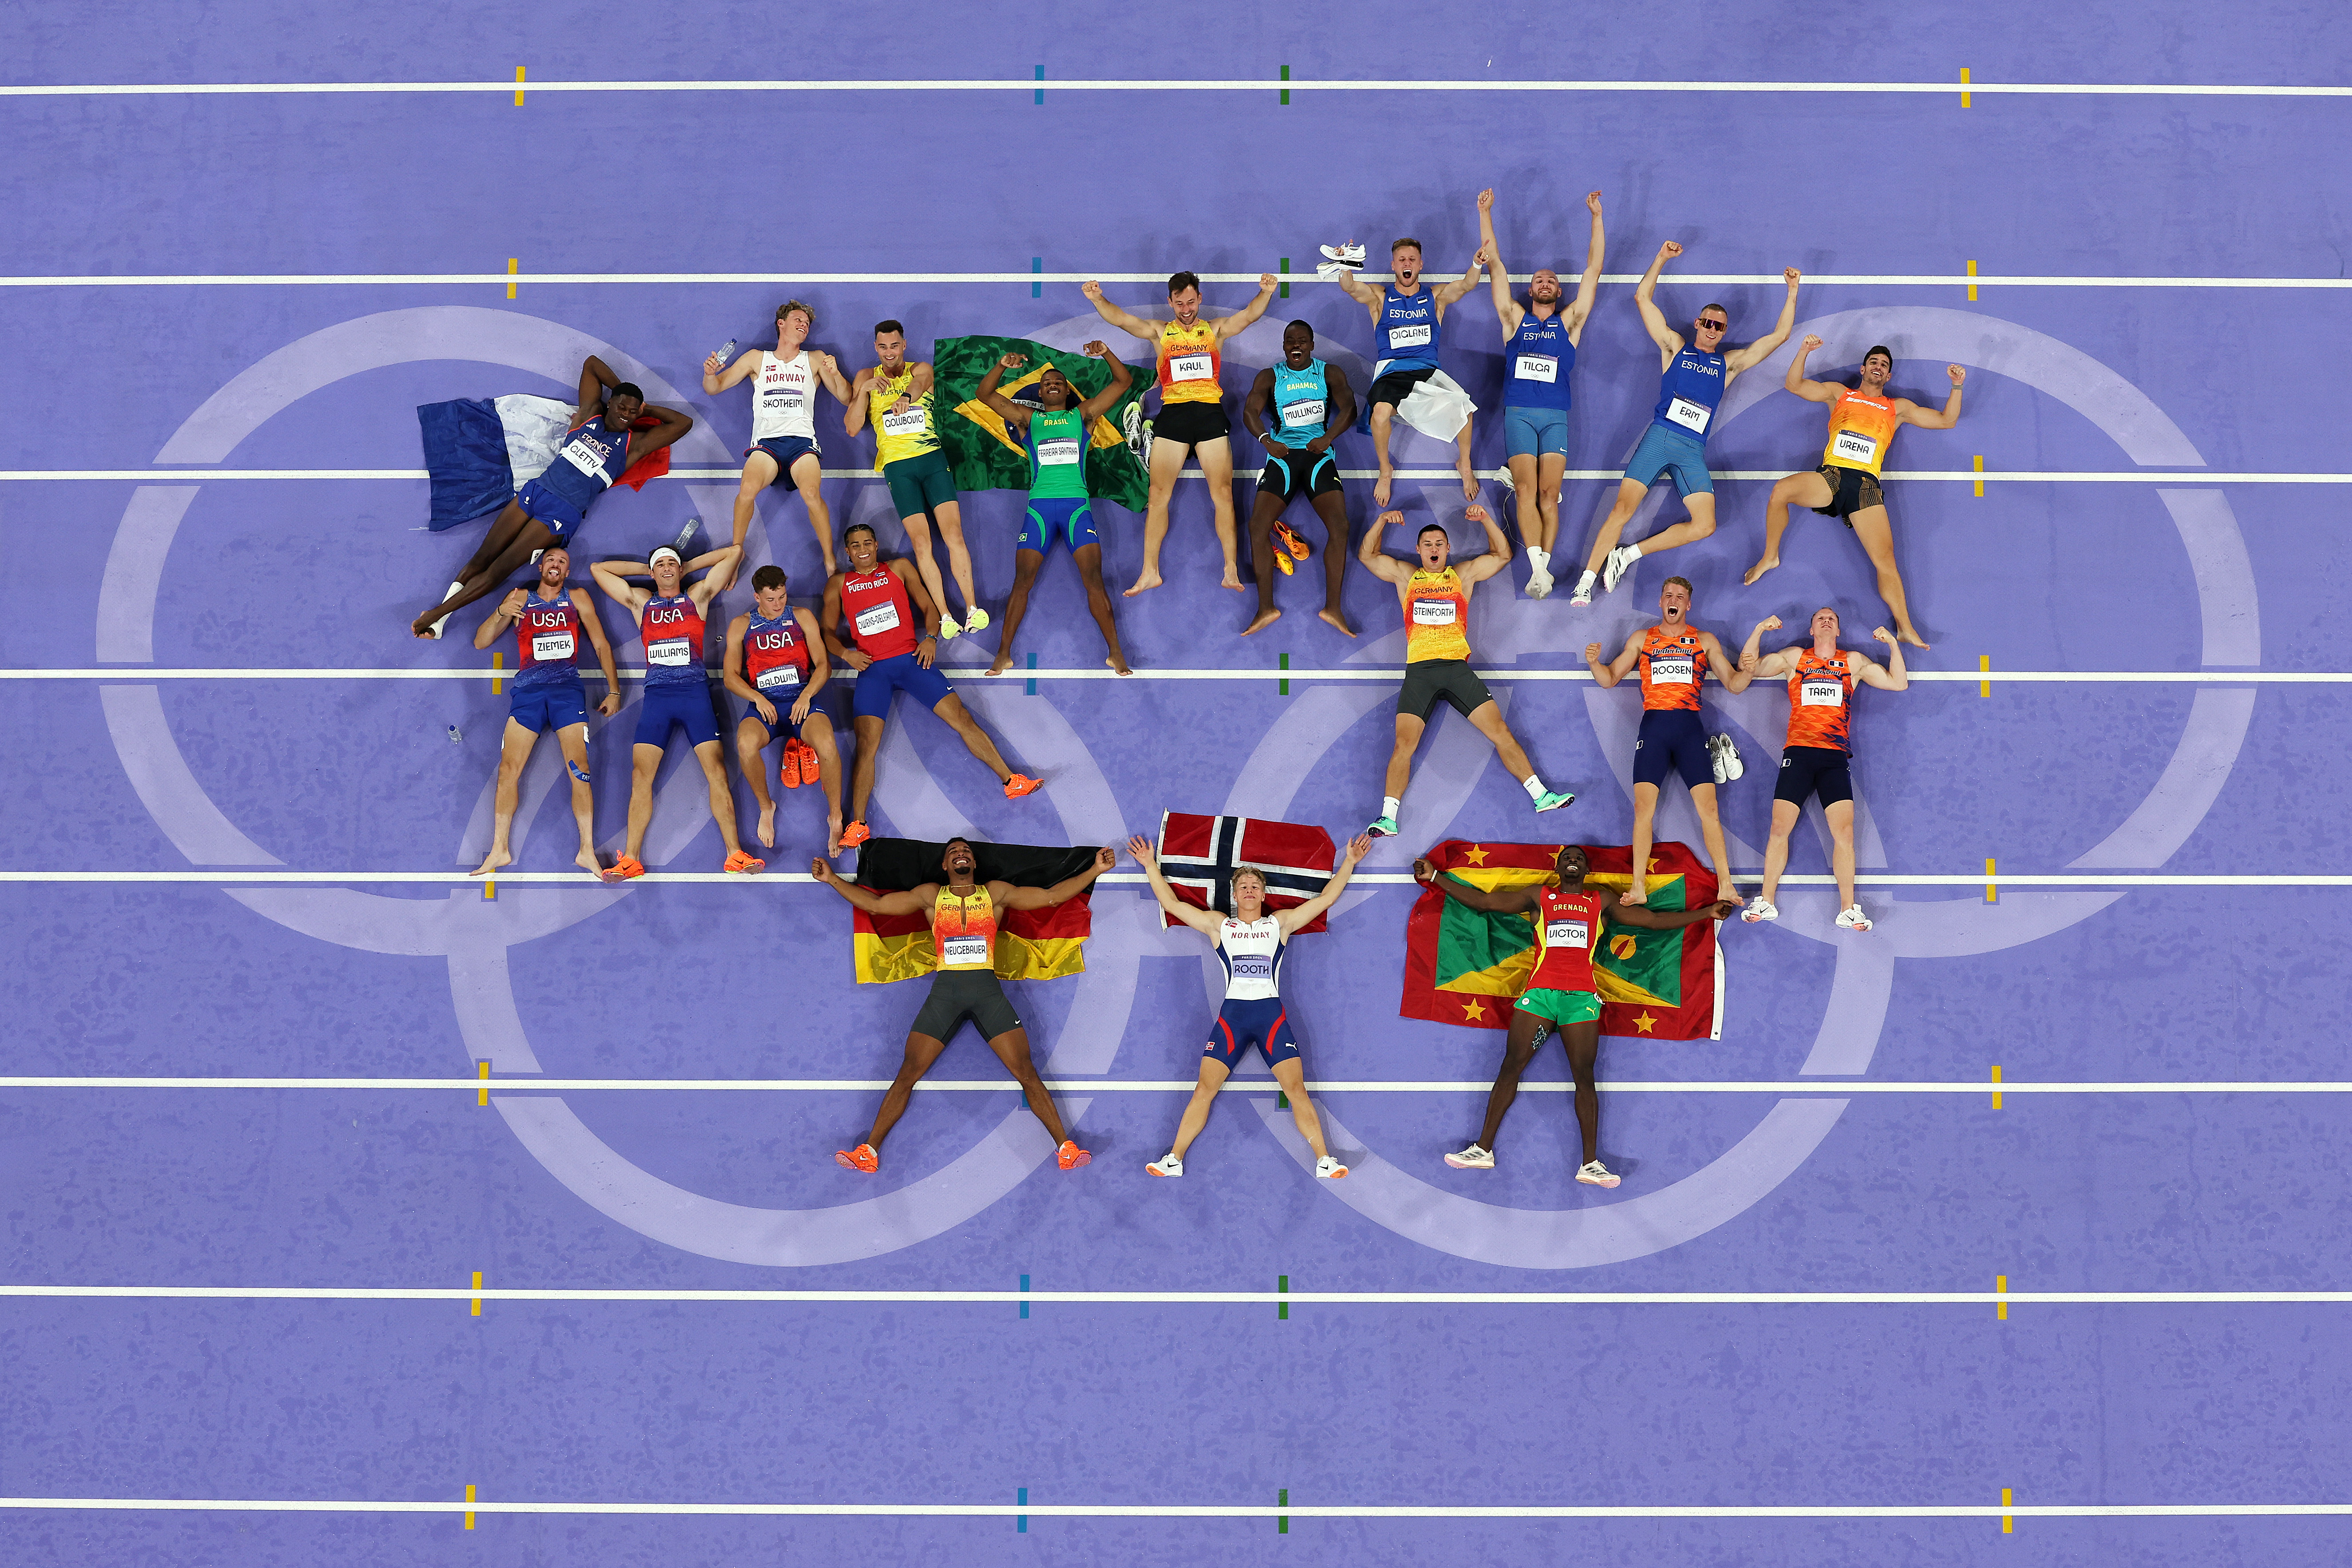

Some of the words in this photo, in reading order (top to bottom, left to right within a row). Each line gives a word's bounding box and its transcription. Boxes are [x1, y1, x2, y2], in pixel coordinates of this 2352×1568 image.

[1390, 308, 1428, 319] ESTONIA
[1391, 328, 1429, 339] OIGLANE
[1180, 362, 1204, 372] KAUL
[1523, 361, 1550, 373] TILGA
[1681, 360, 1719, 378] ESTONIA
[766, 373, 805, 383] NORWAY
[1287, 382, 1318, 391] BAHAMAS
[763, 399, 802, 408] SKOTHEIM
[1285, 405, 1323, 420] MULLINGS
[1680, 406, 1700, 421] ERM
[885, 414, 923, 428] GOLUBOVIC
[581, 433, 612, 457] FRANCE
[1839, 439, 1869, 454] URENA
[570, 445, 599, 468] GLETTY
[1038, 447, 1058, 457] FERREIRA
[1058, 447, 1078, 456] SANTANA
[848, 582, 873, 594] PUERTO
[873, 577, 889, 588] RICO
[652, 609, 684, 623] USA
[1414, 607, 1454, 616] STEINFORTH
[533, 612, 567, 627] USA
[858, 610, 896, 630] OWENS-DELERME
[537, 640, 571, 651] ZIEMEK
[757, 631, 794, 650] USA
[650, 647, 688, 658] WILLIAMS
[1653, 665, 1691, 675] ROOSEN
[759, 673, 797, 687] BALDWIN
[1808, 687, 1835, 697] TAAM
[942, 903, 985, 912] GERMANY
[1553, 904, 1588, 914] GRENADA
[1549, 929, 1585, 939] VICTOR
[945, 945, 985, 955] NEUGEBAUER
[1235, 965, 1269, 974] ROOTH
